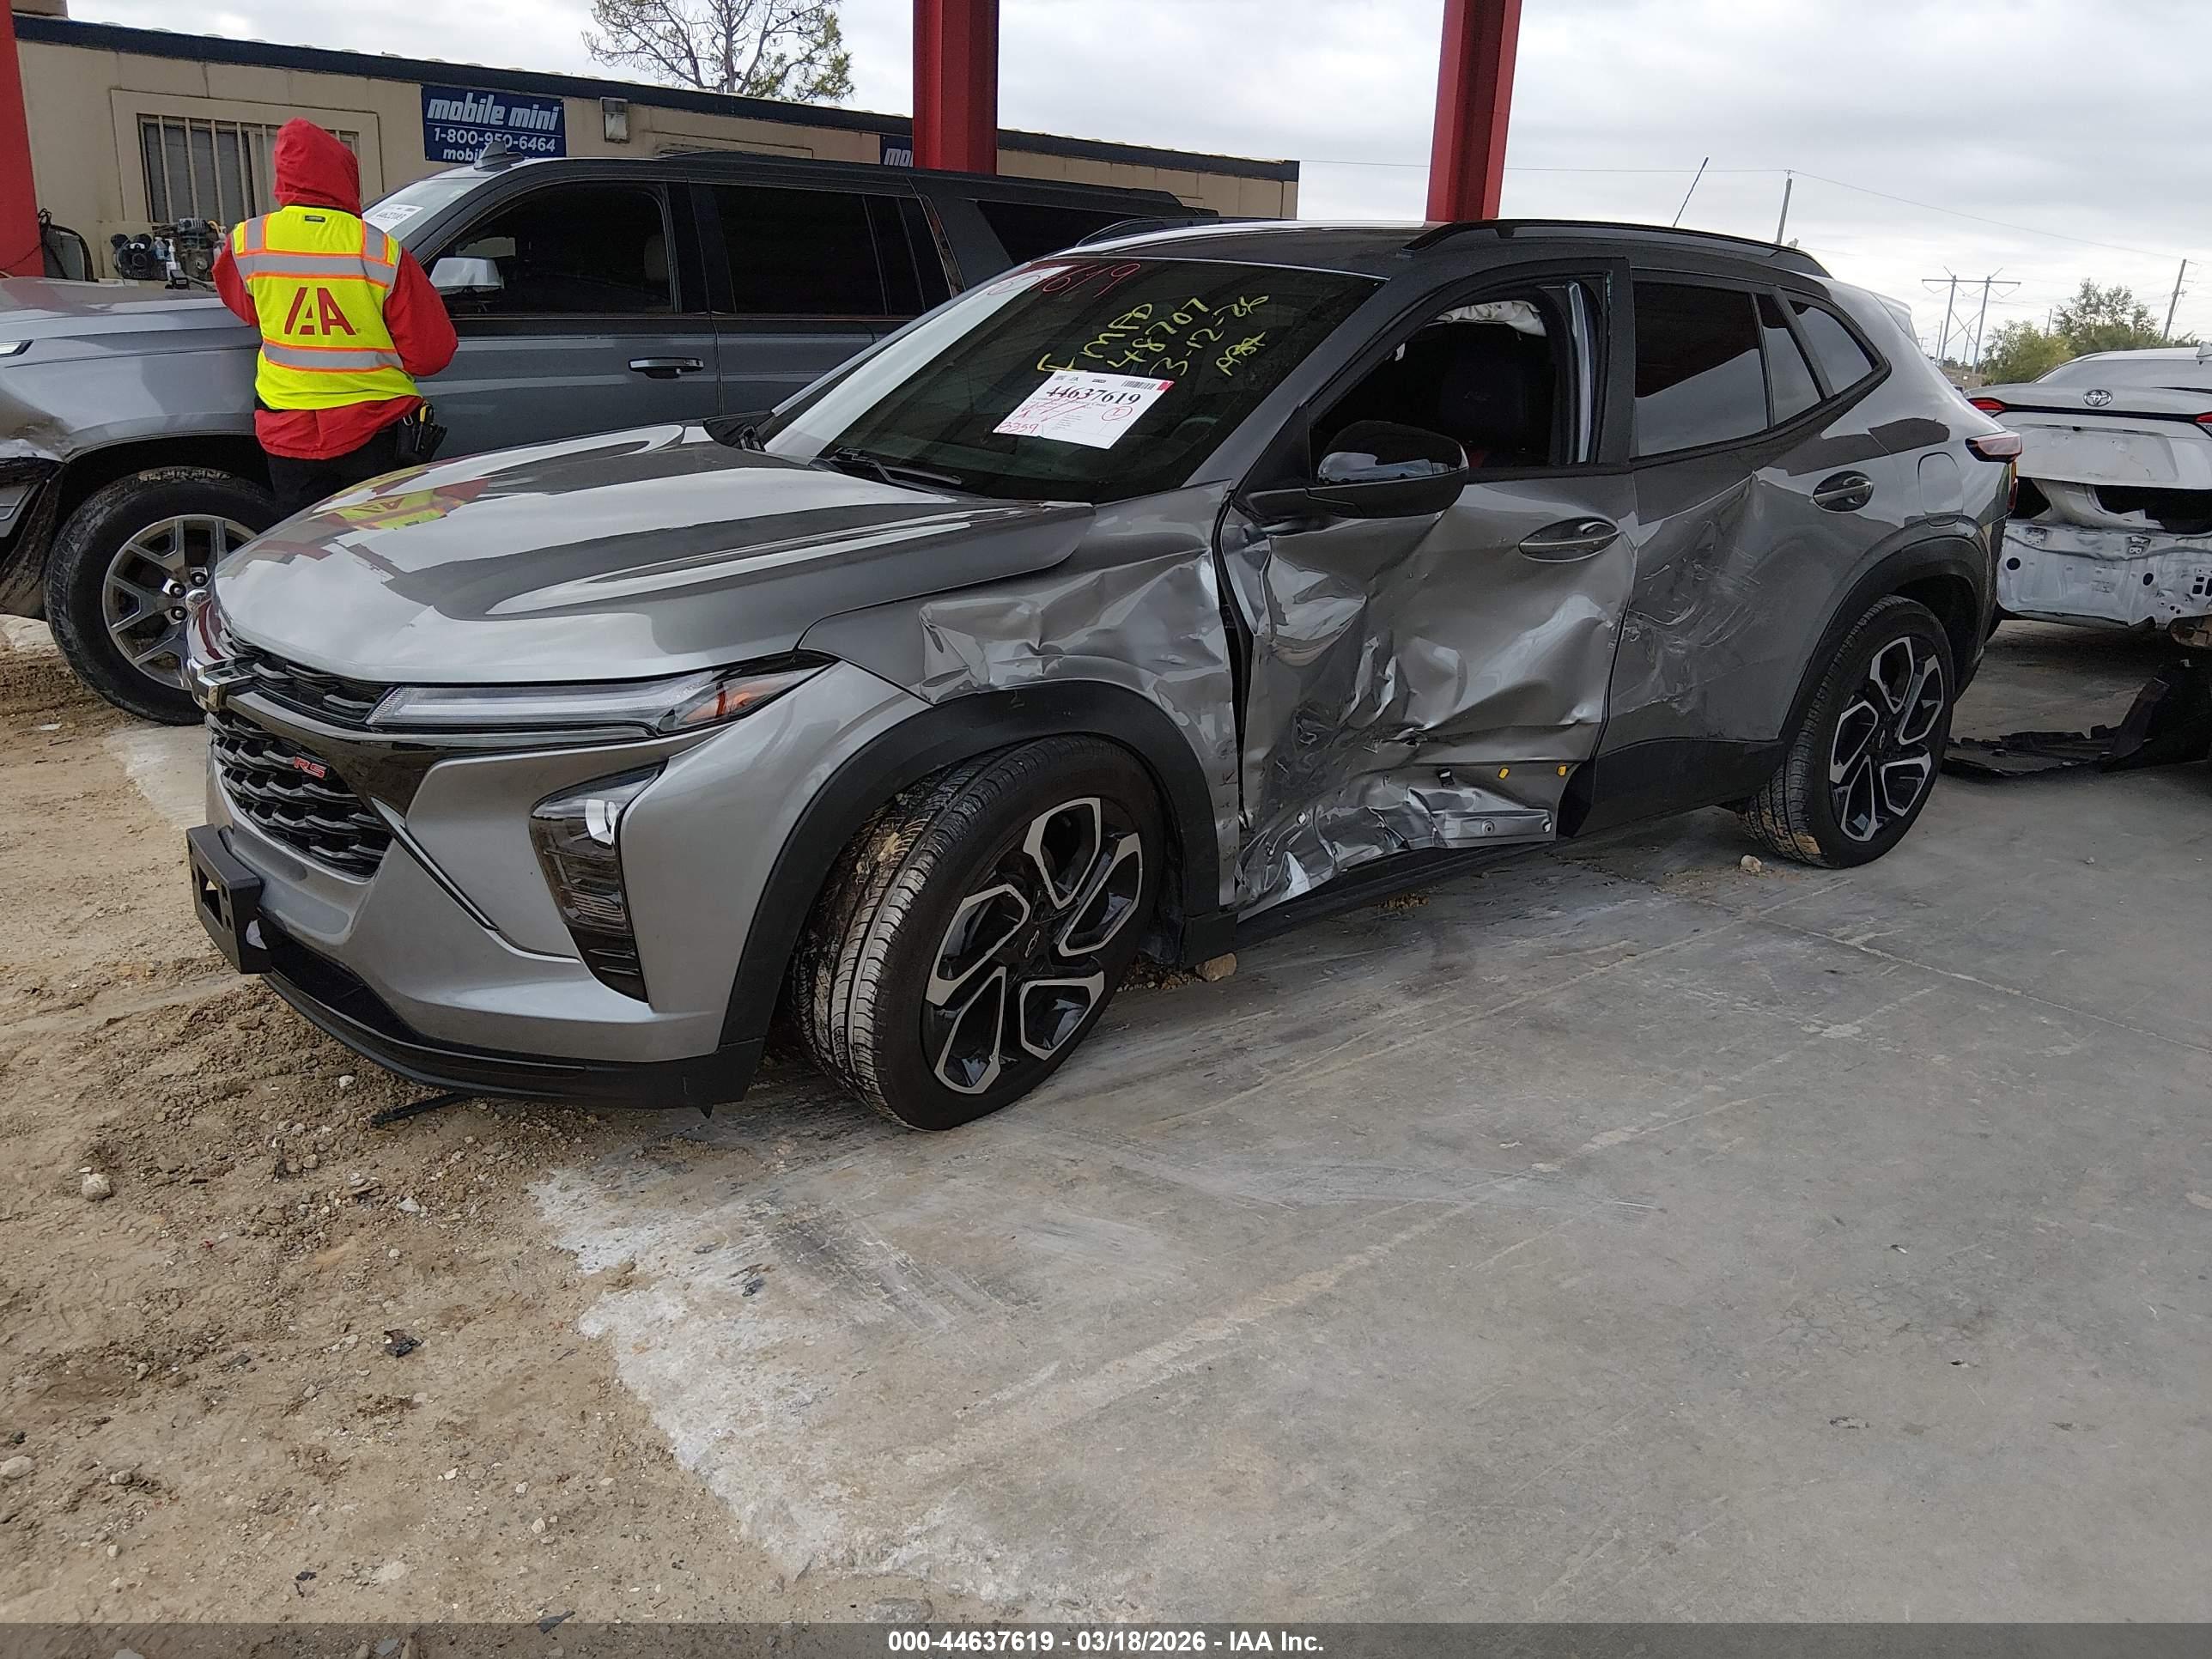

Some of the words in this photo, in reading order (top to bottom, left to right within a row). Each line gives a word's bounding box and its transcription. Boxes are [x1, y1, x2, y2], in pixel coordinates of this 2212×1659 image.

[427, 92, 506, 125] mobile
[508, 104, 558, 131] mini
[884, 148, 914, 167] mo
[1106, 297, 1210, 368] 48707
[1045, 384, 1142, 405] 44637619
[294, 757, 327, 778] RS
